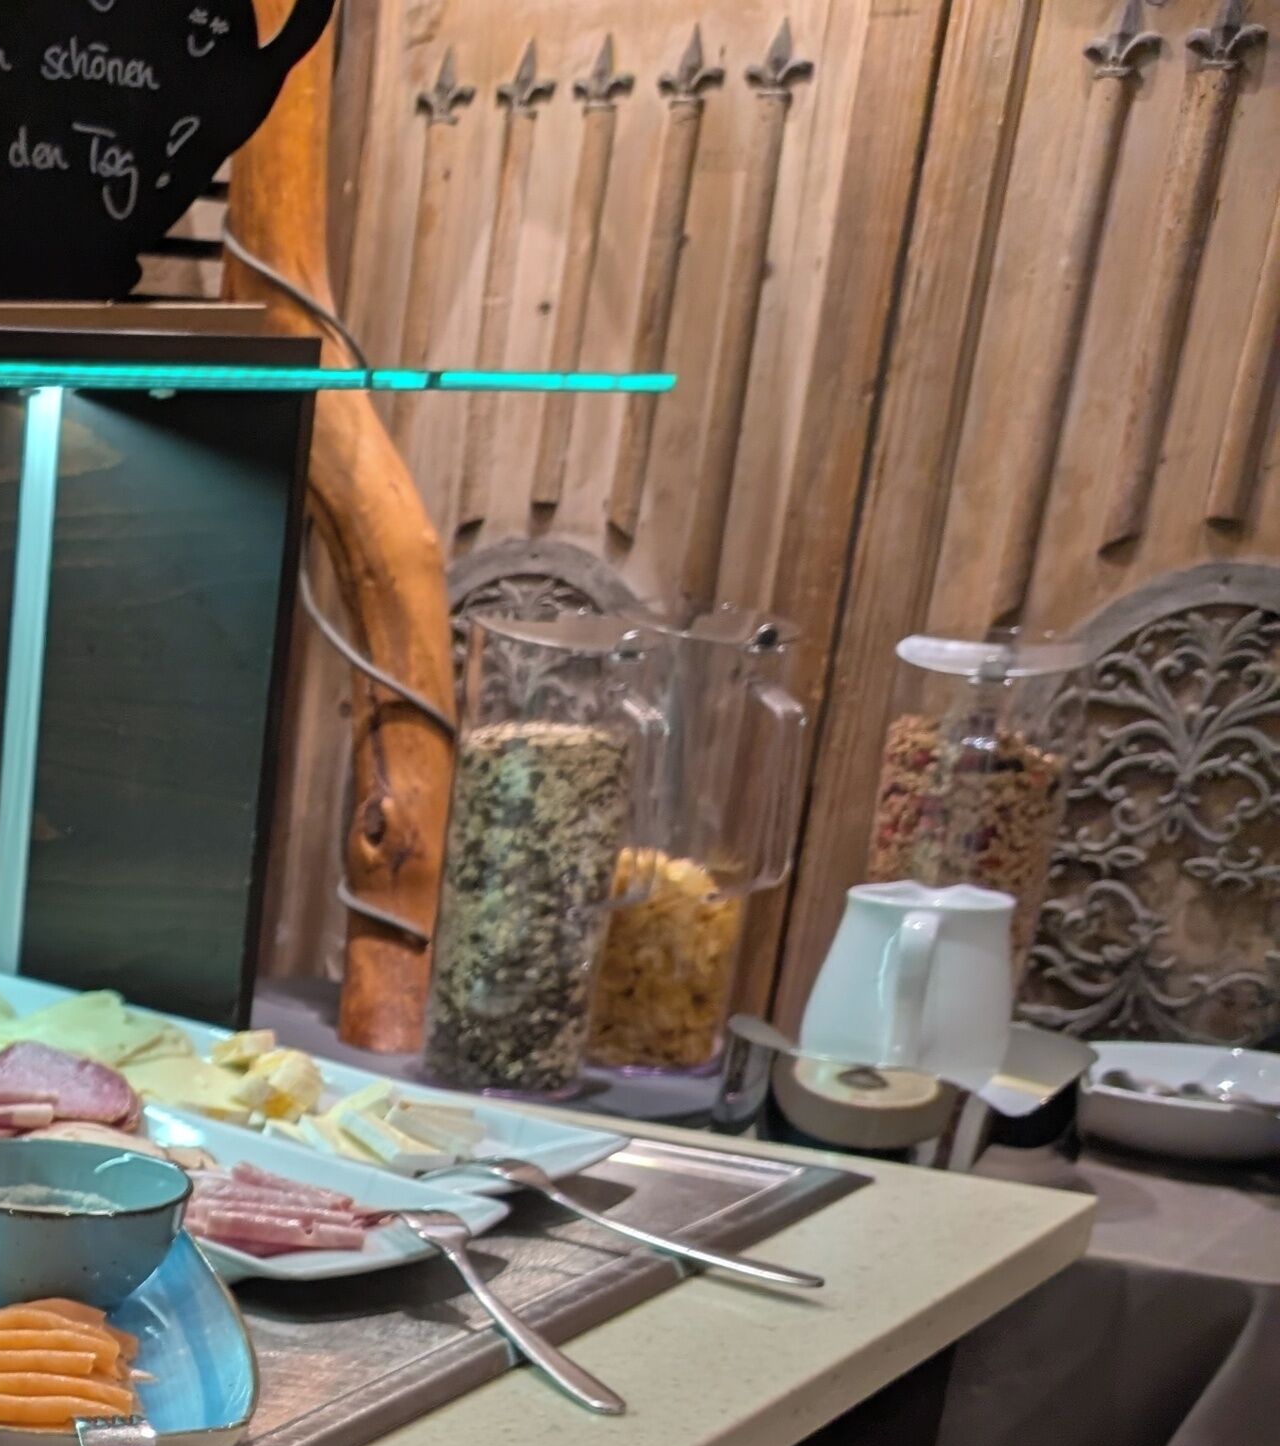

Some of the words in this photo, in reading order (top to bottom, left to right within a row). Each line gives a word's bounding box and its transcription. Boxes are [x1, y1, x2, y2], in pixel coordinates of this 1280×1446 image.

[41, 36, 160, 89] schönen
[8, 126, 69, 170] den
[72, 121, 139, 219] Tag
